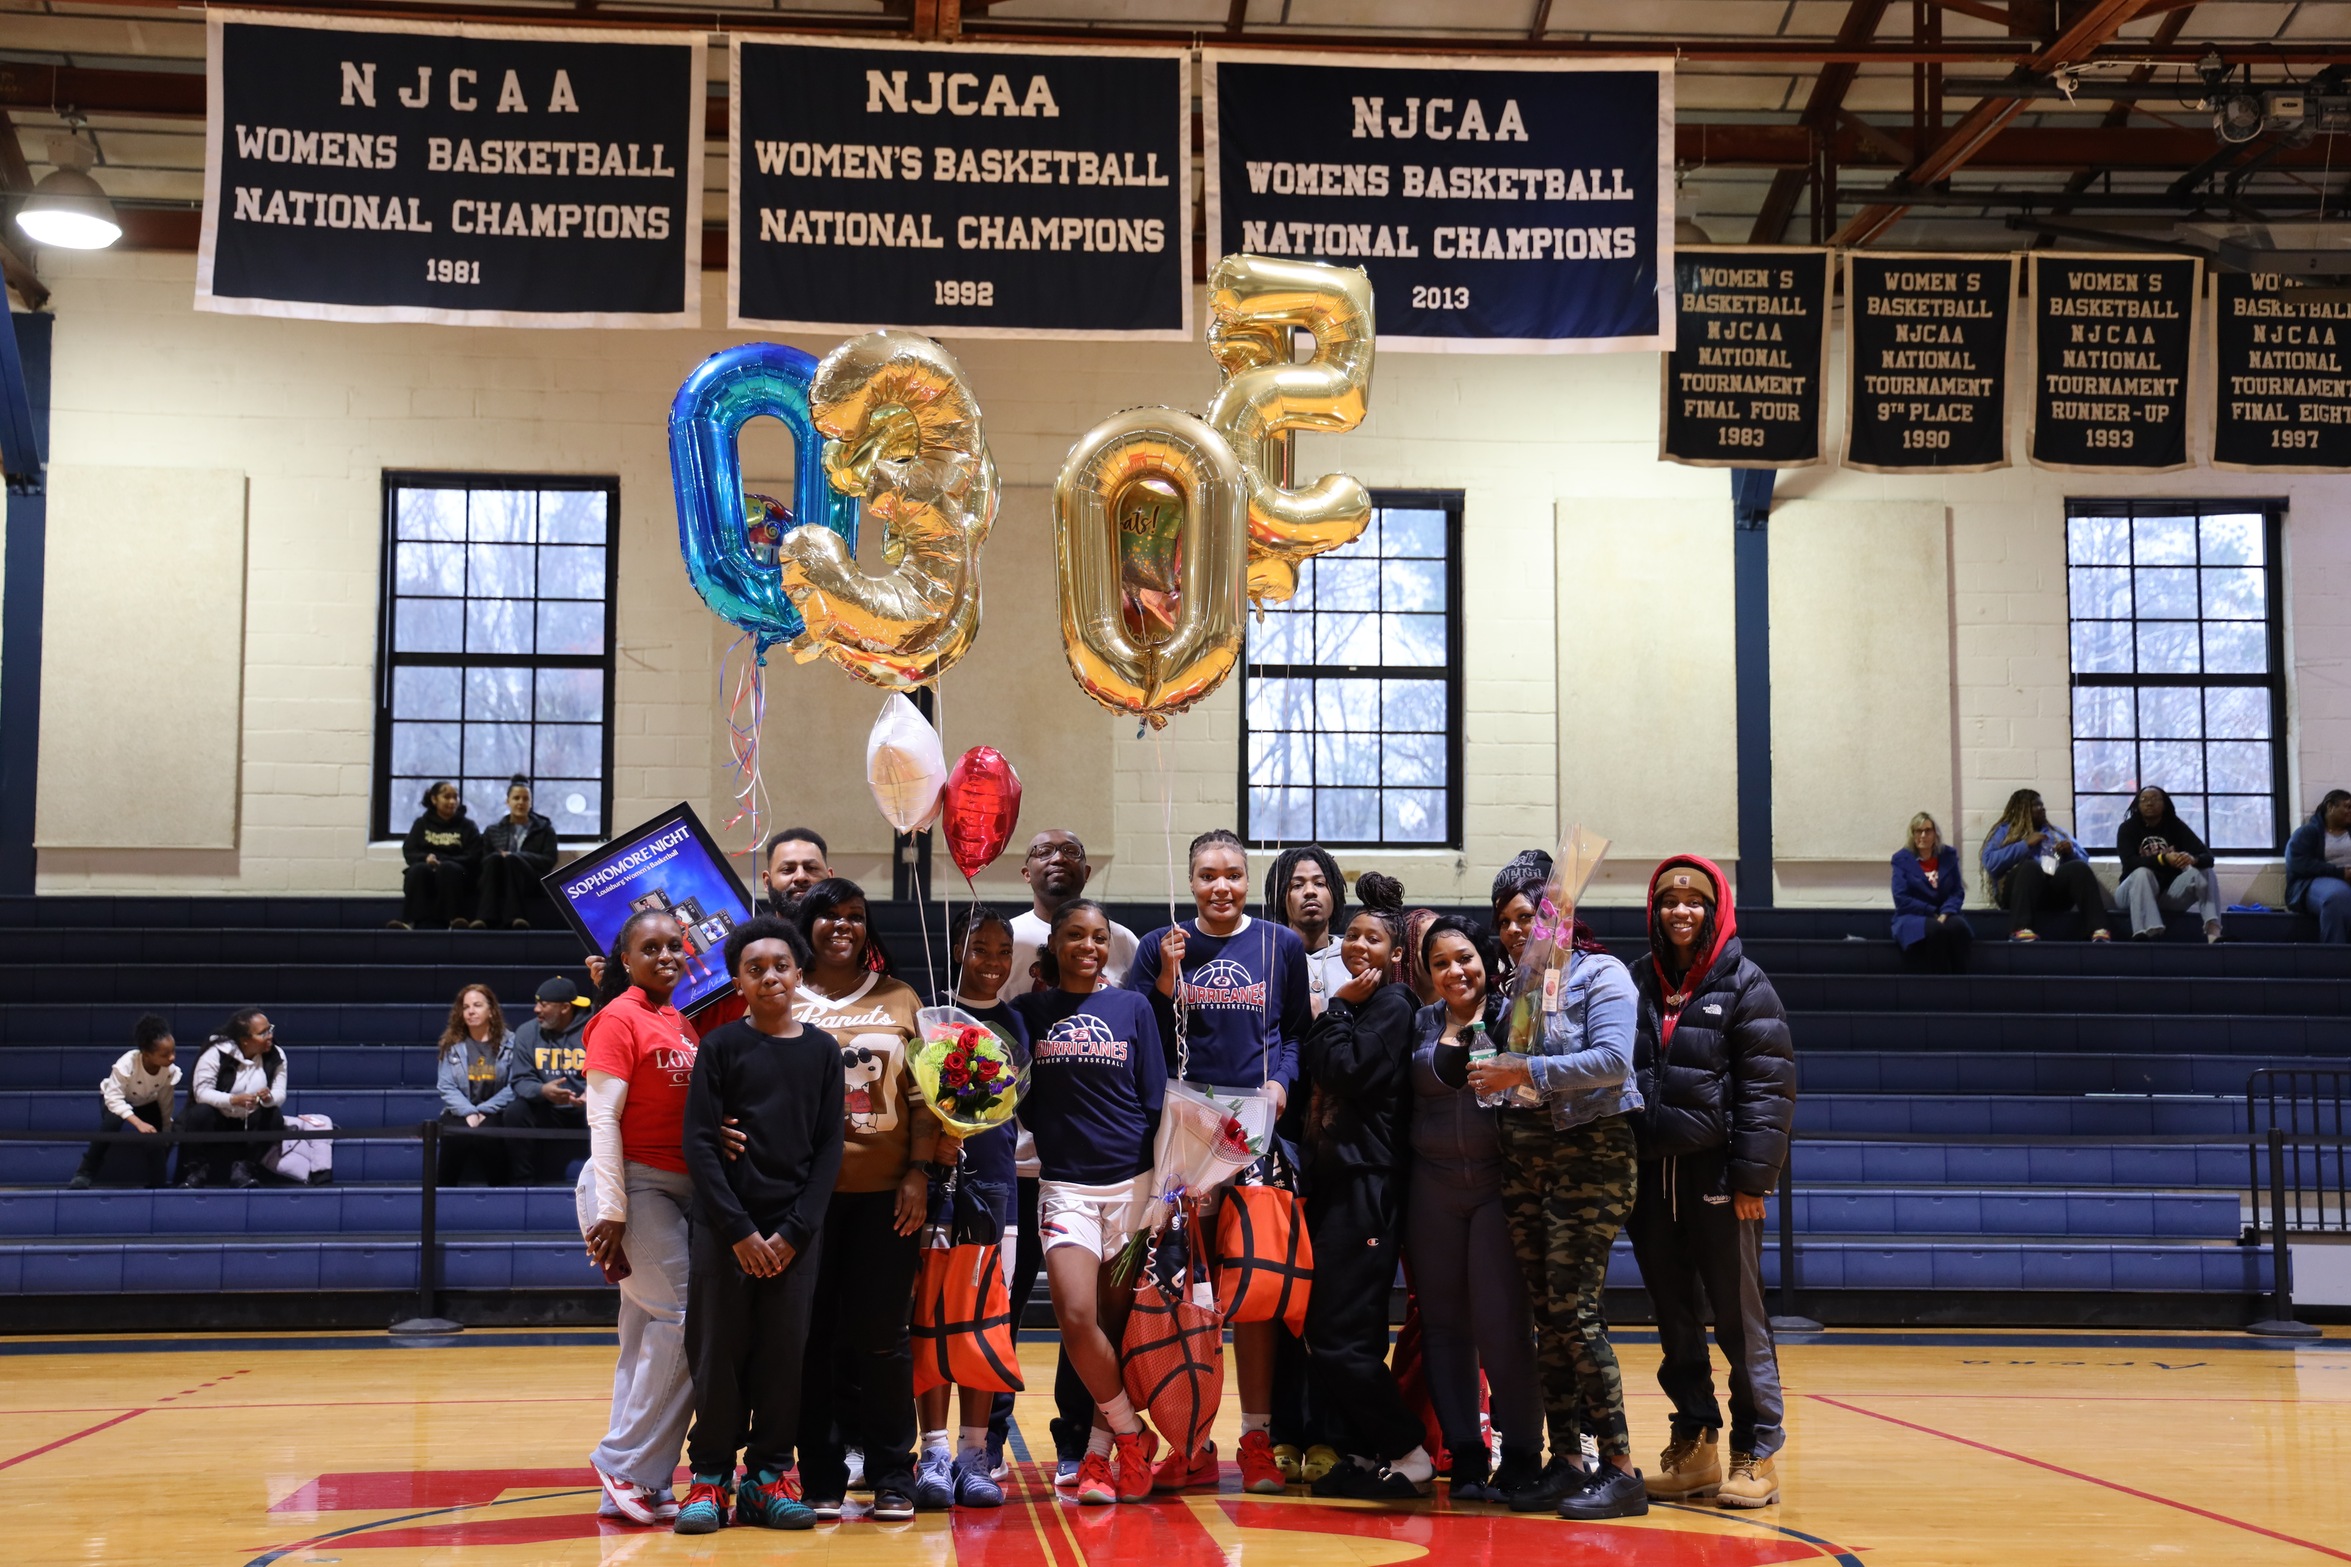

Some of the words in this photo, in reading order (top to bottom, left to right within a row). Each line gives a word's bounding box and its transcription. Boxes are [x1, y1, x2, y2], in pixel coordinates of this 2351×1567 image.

[867, 71, 1059, 116] NJCAA
[1352, 97, 1528, 141] NJCAA
[236, 125, 397, 168] WOMENS
[428, 138, 674, 177] BASKETBALL
[755, 141, 922, 180] WOMEN'S
[934, 148, 1169, 186] BASKETBALL
[1247, 162, 1389, 196] WOMENS
[1403, 166, 1633, 200] BASKETBALL
[234, 187, 432, 232] NATIONAL
[452, 200, 669, 239] CHAMPIONS
[761, 208, 943, 248] NATIONAL
[958, 216, 1164, 252] CHAMPIONS
[1243, 221, 1418, 257] NATIONAL
[1434, 227, 1635, 259] CHAMPIONS
[427, 259, 480, 284] 1981
[936, 281, 993, 306] 1992
[1413, 286, 1469, 309] 2013
[1682, 293, 1806, 315] BASKETBALL
[1868, 297, 1992, 317] BASKETBALL
[2050, 298, 2179, 318] BASKETBALL
[1708, 321, 1782, 341] NJCAA
[1896, 324, 1963, 344] NJCAA
[2072, 325, 2155, 344] NJCAA
[2254, 325, 2335, 345] NJCAA
[1699, 347, 1791, 368] NATIONAL
[1882, 351, 1975, 370] NATIONAL
[2063, 350, 2161, 370] NATIONAL
[2249, 351, 2341, 371] NATIONAL
[1680, 373, 1806, 395] TOURNAMENT
[1865, 376, 1993, 396] TOURNAMENT
[2047, 375, 2178, 396] TOURNAMENT
[1684, 400, 1740, 419] FINAL
[1751, 402, 1800, 421] FOUR
[1878, 403, 1904, 421] 9TH
[1910, 403, 1973, 422] PLACE
[2052, 401, 2169, 422] RUNNER-UP
[2232, 403, 2289, 421] FINAL
[1719, 427, 1764, 446] 1983
[1904, 430, 1950, 448] 1990
[2087, 429, 2133, 447] 1993
[2272, 430, 2318, 448] 1997
[568, 847, 652, 899] SOPHOMORE
[648, 825, 690, 856] NIGHT
[596, 879, 626, 897] Louisburg
[650, 849, 679, 869] Basketball
[792, 1002, 896, 1028] Peanuts
[535, 1047, 587, 1070] FTCC
[1035, 1040, 1127, 1061] HURRICANES
